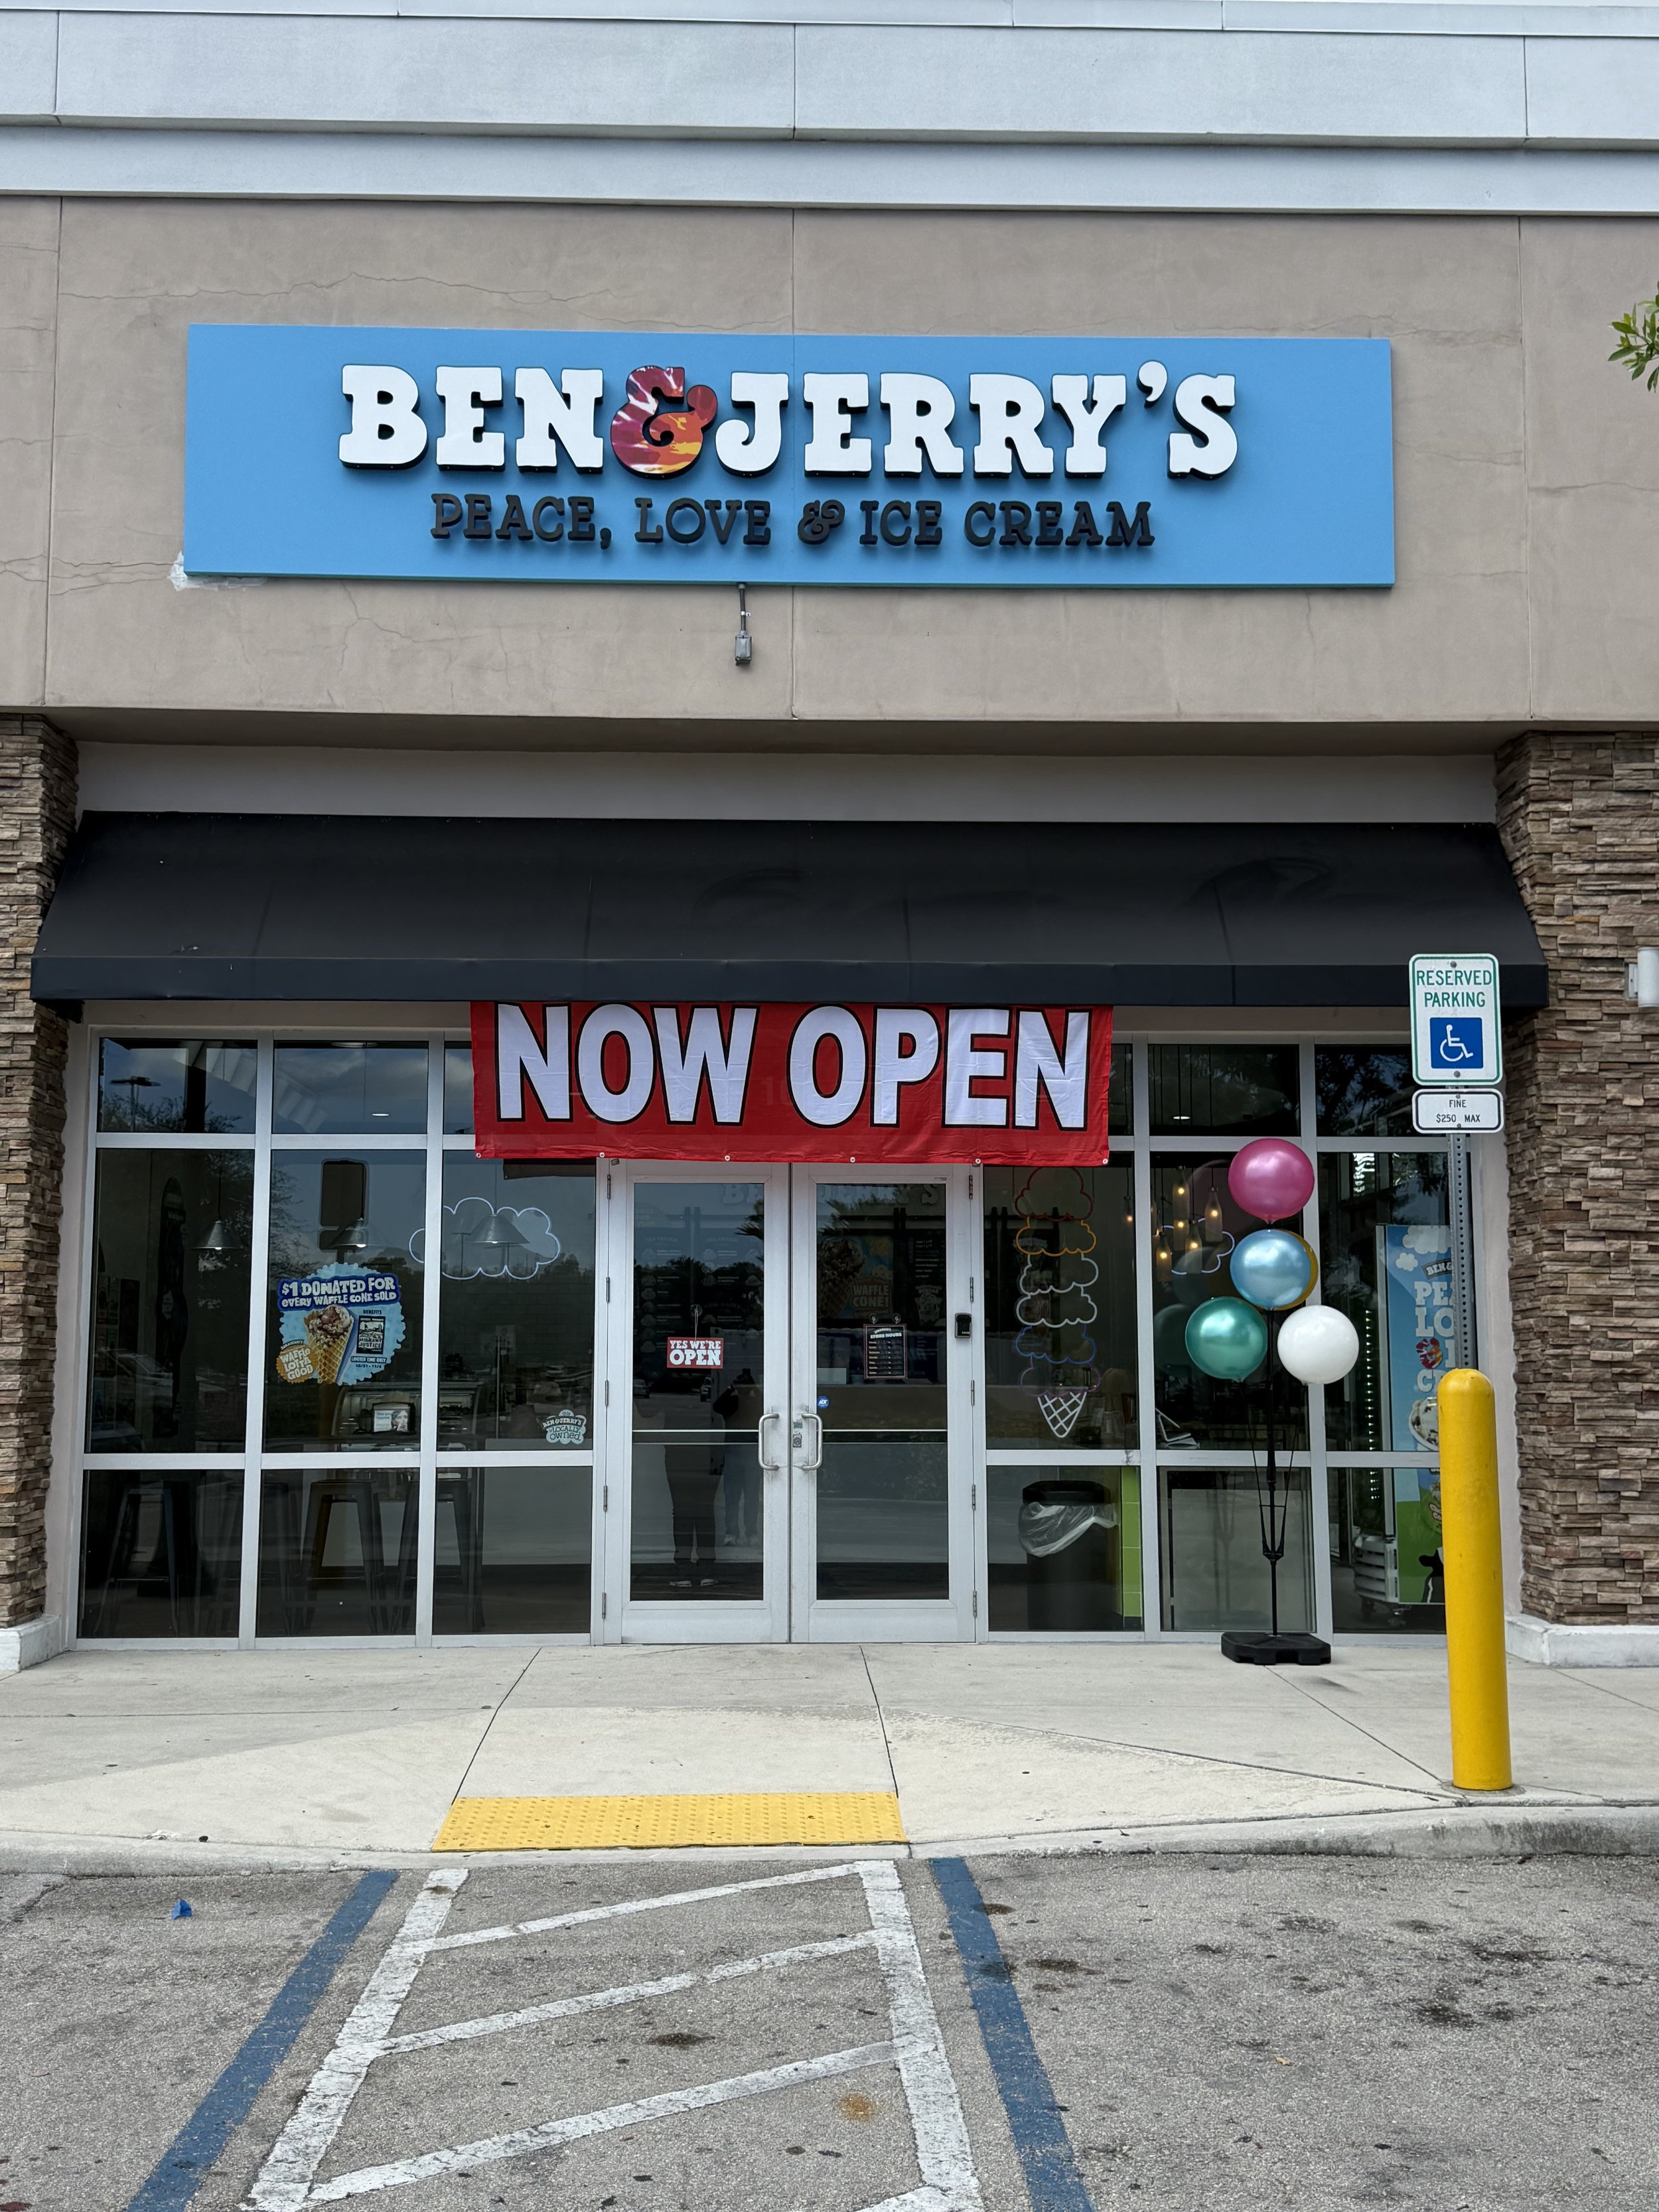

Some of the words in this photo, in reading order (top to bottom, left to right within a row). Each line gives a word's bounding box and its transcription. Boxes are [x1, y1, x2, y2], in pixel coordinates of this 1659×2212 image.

[430, 492, 612, 550] PEACE,
[635, 497, 771, 545] LOVE
[797, 499, 845, 546] &
[859, 500, 942, 546] ICE
[964, 500, 1155, 547] CREAM
[1416, 970, 1492, 986] RESERVED
[1423, 992, 1486, 1007] PARKING
[494, 1001, 761, 1126] NOW
[787, 1002, 1092, 1132] OPEN
[1449, 1099, 1467, 1108] FINE
[1436, 1114, 1457, 1123] $250
[1464, 1114, 1480, 1123] MAX
[281, 1282, 299, 1297] $1
[301, 1280, 366, 1296] DONATED
[368, 1277, 396, 1291] FOR
[852, 1284, 889, 1296] WAFFLE
[314, 1295, 348, 1306] WAFFLE
[374, 1291, 397, 1301] SOLD
[852, 1295, 890, 1307] CONE!
[670, 1340, 688, 1349] YES
[689, 1340, 721, 1349] WE'RE
[283, 1356, 313, 1372] LOTTA
[669, 1349, 721, 1366] OPEN
[287, 1364, 314, 1380] GOOD
